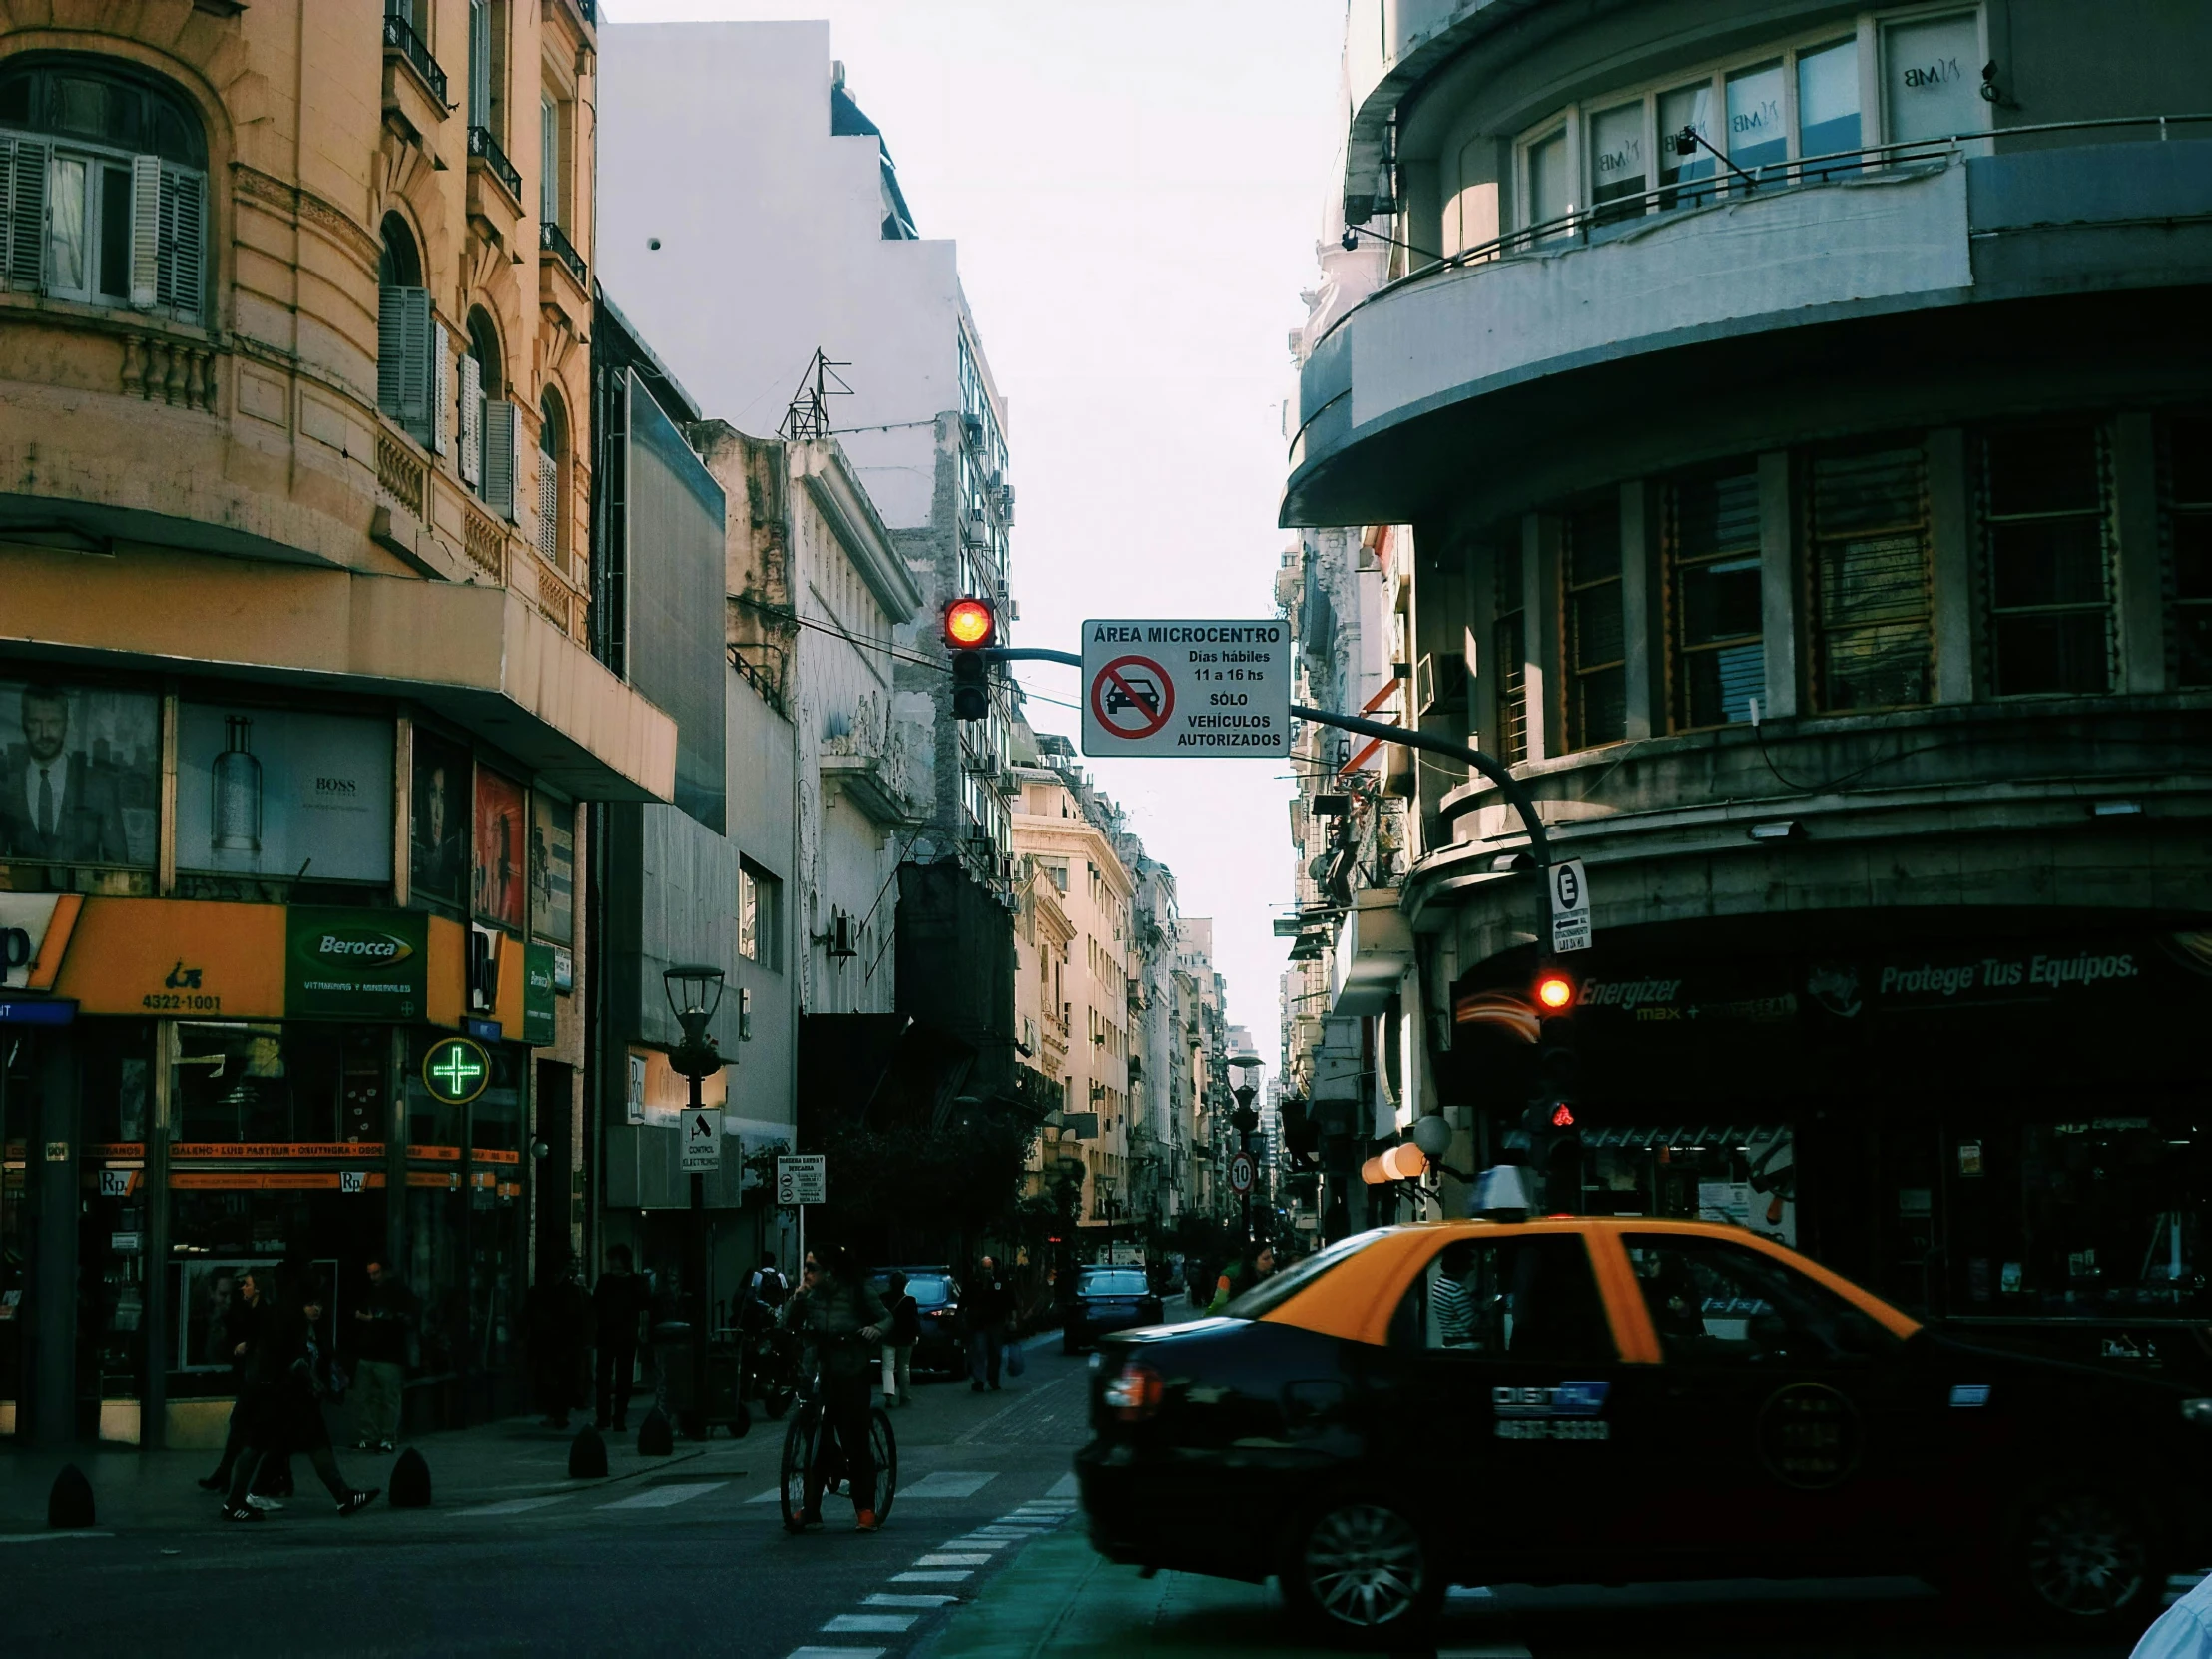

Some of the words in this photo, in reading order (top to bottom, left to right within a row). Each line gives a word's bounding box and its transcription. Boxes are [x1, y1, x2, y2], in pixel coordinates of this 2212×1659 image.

[1094, 624, 1142, 643] ÁREA
[1148, 627, 1280, 643] MICROCENTRO
[1222, 650, 1271, 663] hábiles
[1194, 668, 1209, 681] 11
[1214, 671, 1223, 681] a
[1227, 668, 1244, 681] 16
[1248, 670, 1264, 681] hs
[1209, 690, 1248, 706] SÓLO
[1187, 712, 1271, 728] VEHÍCULOS
[1177, 733, 1281, 747] AUTORIZADOS
[316, 777, 356, 792] BOSS
[1560, 873, 1576, 901] E
[319, 935, 396, 956] Berocca
[1880, 963, 1973, 996] Protege
[1981, 957, 2023, 987] Tus
[2029, 950, 2139, 988] Equipos.
[1576, 976, 1682, 1010] Energizer
[143, 995, 222, 1010] 4322-1001
[1637, 1005, 1682, 1022] max
[1234, 1164, 1249, 1183] 10
